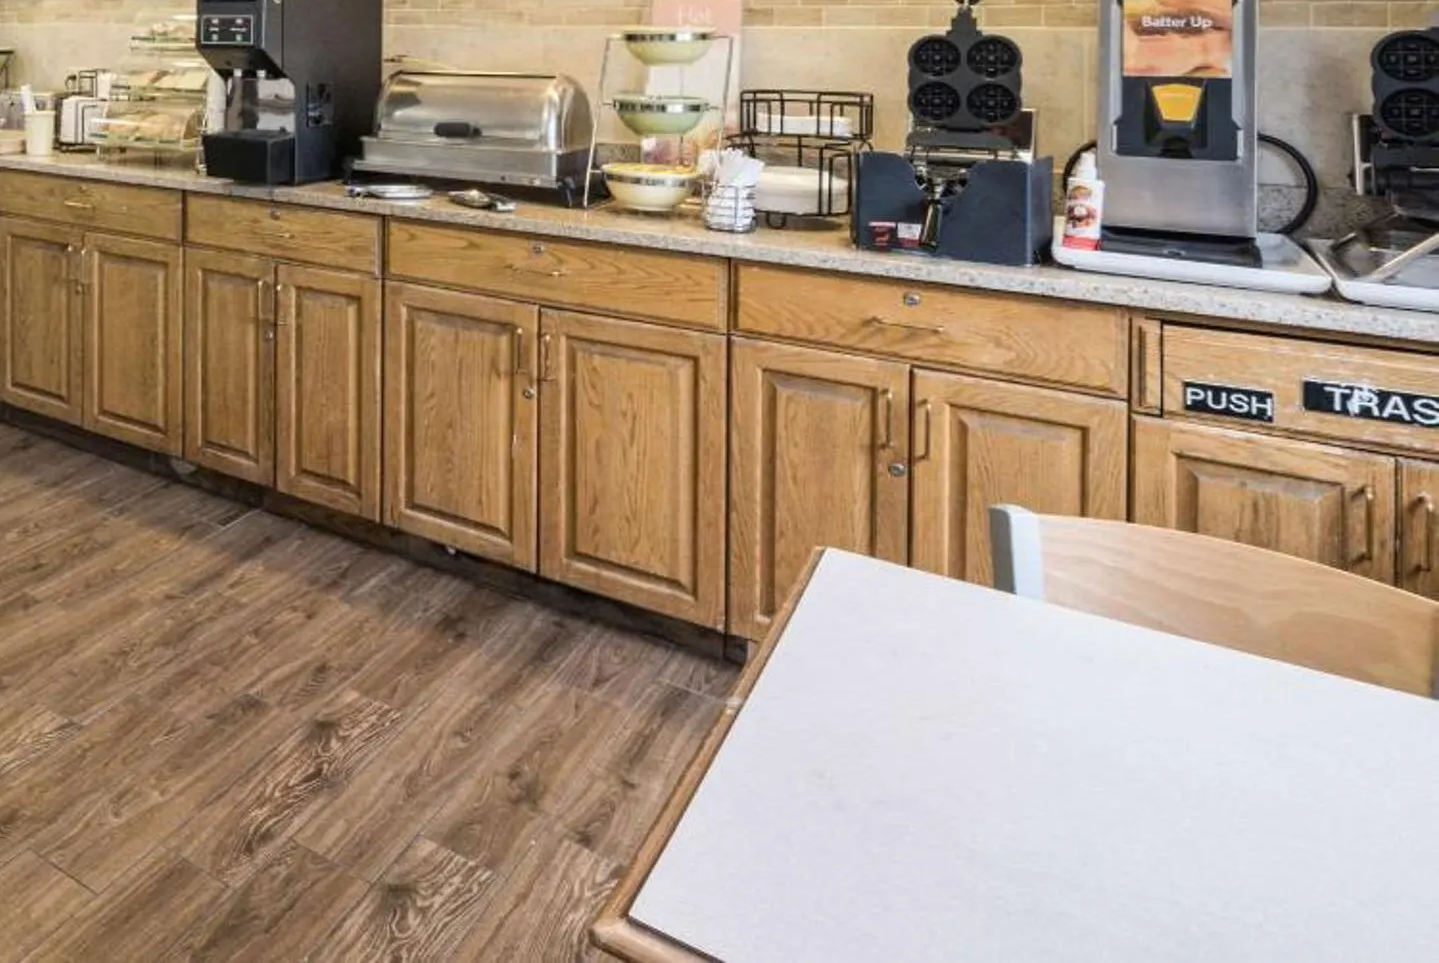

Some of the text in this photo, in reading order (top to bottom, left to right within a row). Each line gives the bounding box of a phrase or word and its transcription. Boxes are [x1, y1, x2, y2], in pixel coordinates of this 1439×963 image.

[1141, 15, 1213, 30] Batter Up
[1185, 387, 1273, 418] PUSH
